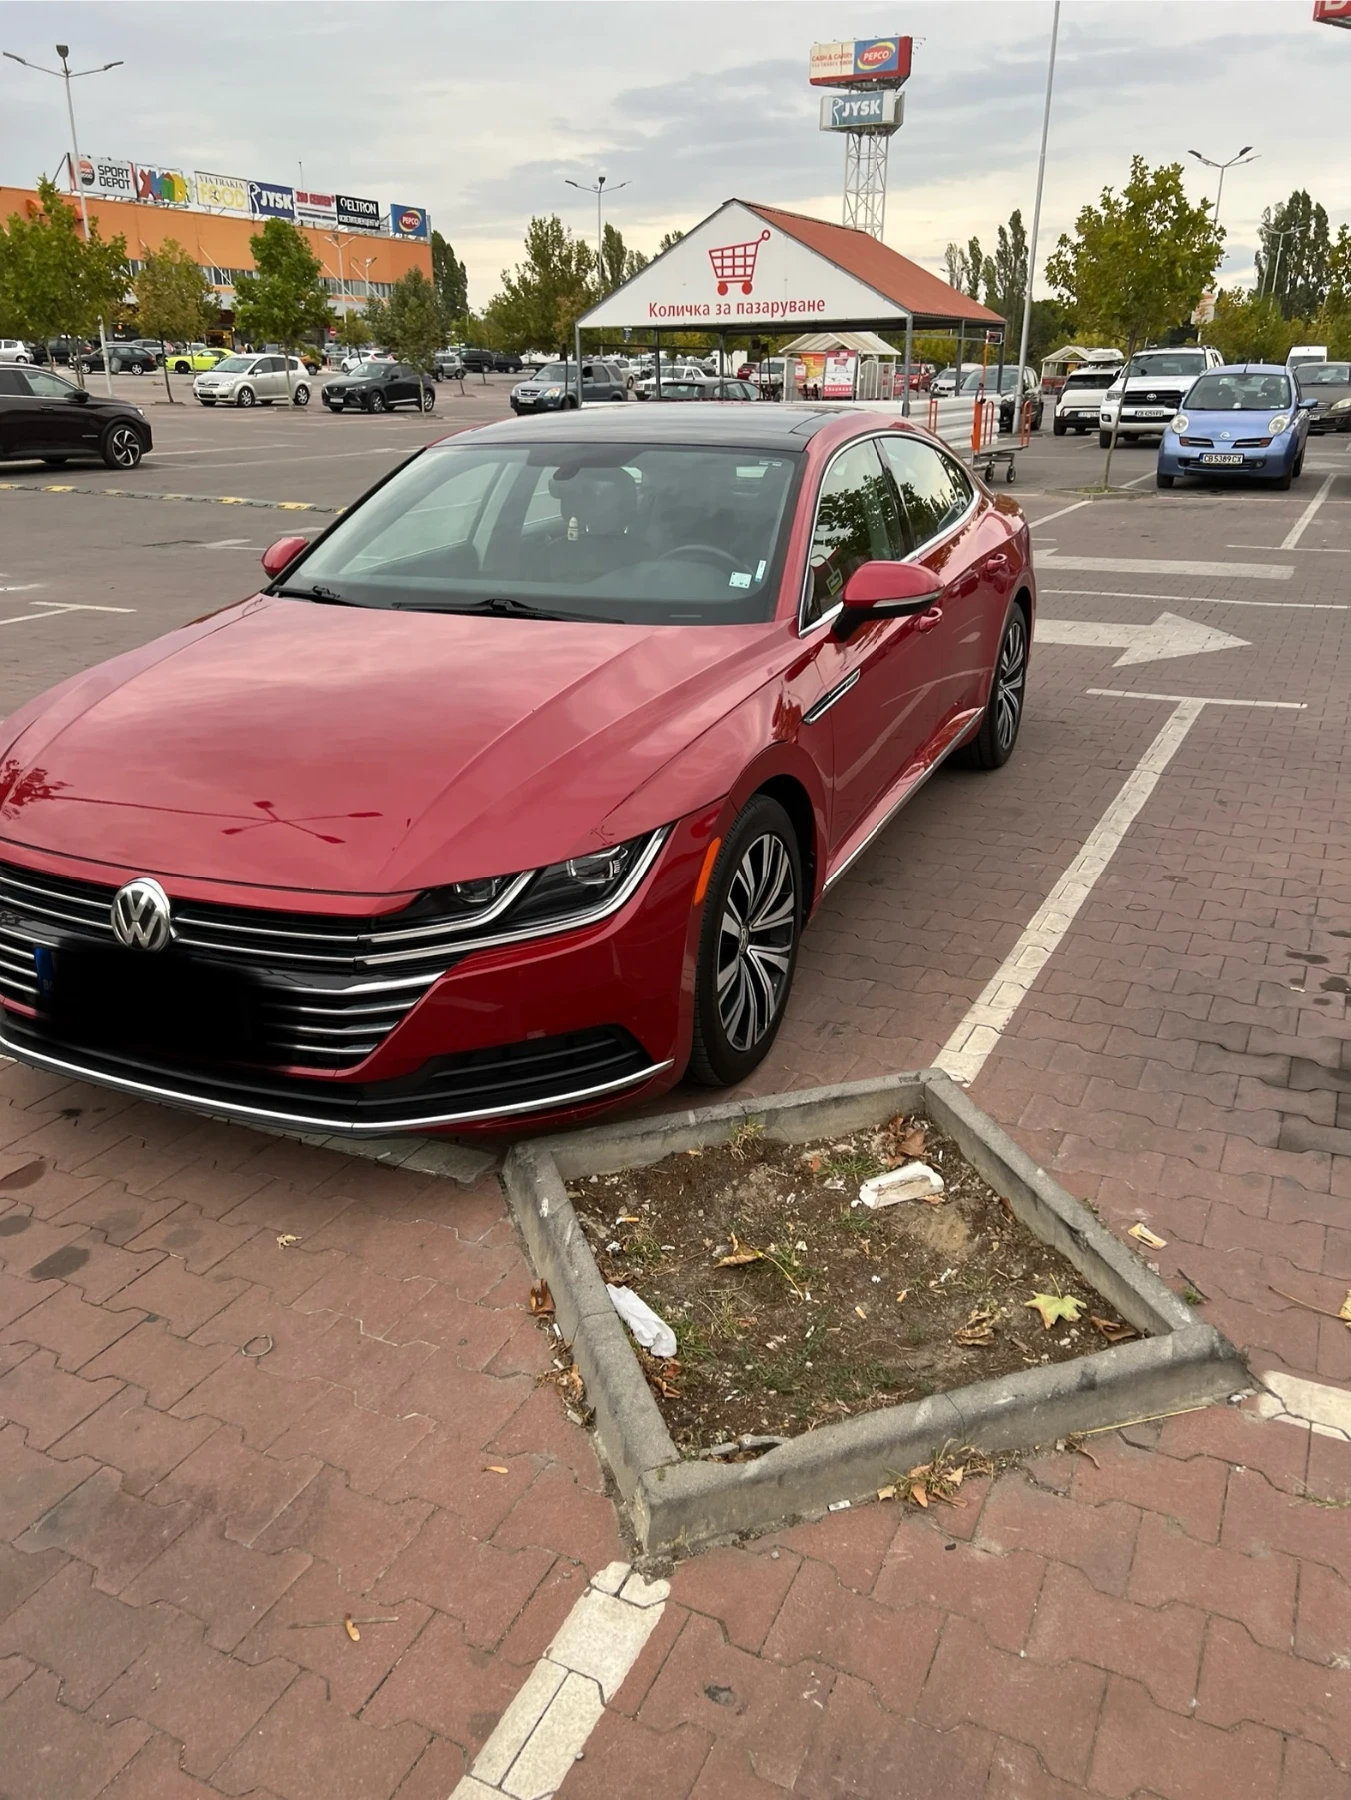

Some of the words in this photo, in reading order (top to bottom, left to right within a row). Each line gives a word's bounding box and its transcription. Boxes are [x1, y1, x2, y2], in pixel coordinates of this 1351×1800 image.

[863, 50, 890, 61] PEPCO
[842, 99, 881, 117] JYSK
[97, 164, 130, 179] SPORT
[99, 176, 131, 190] DEPOT
[199, 175, 214, 185] VIA
[215, 178, 244, 189] TRAKIA
[260, 190, 294, 210] JYSK
[401, 216, 419, 226] PEPCO
[649, 302, 710, 318] Количка
[715, 302, 731, 316] за
[736, 299, 826, 318] пазаруване
